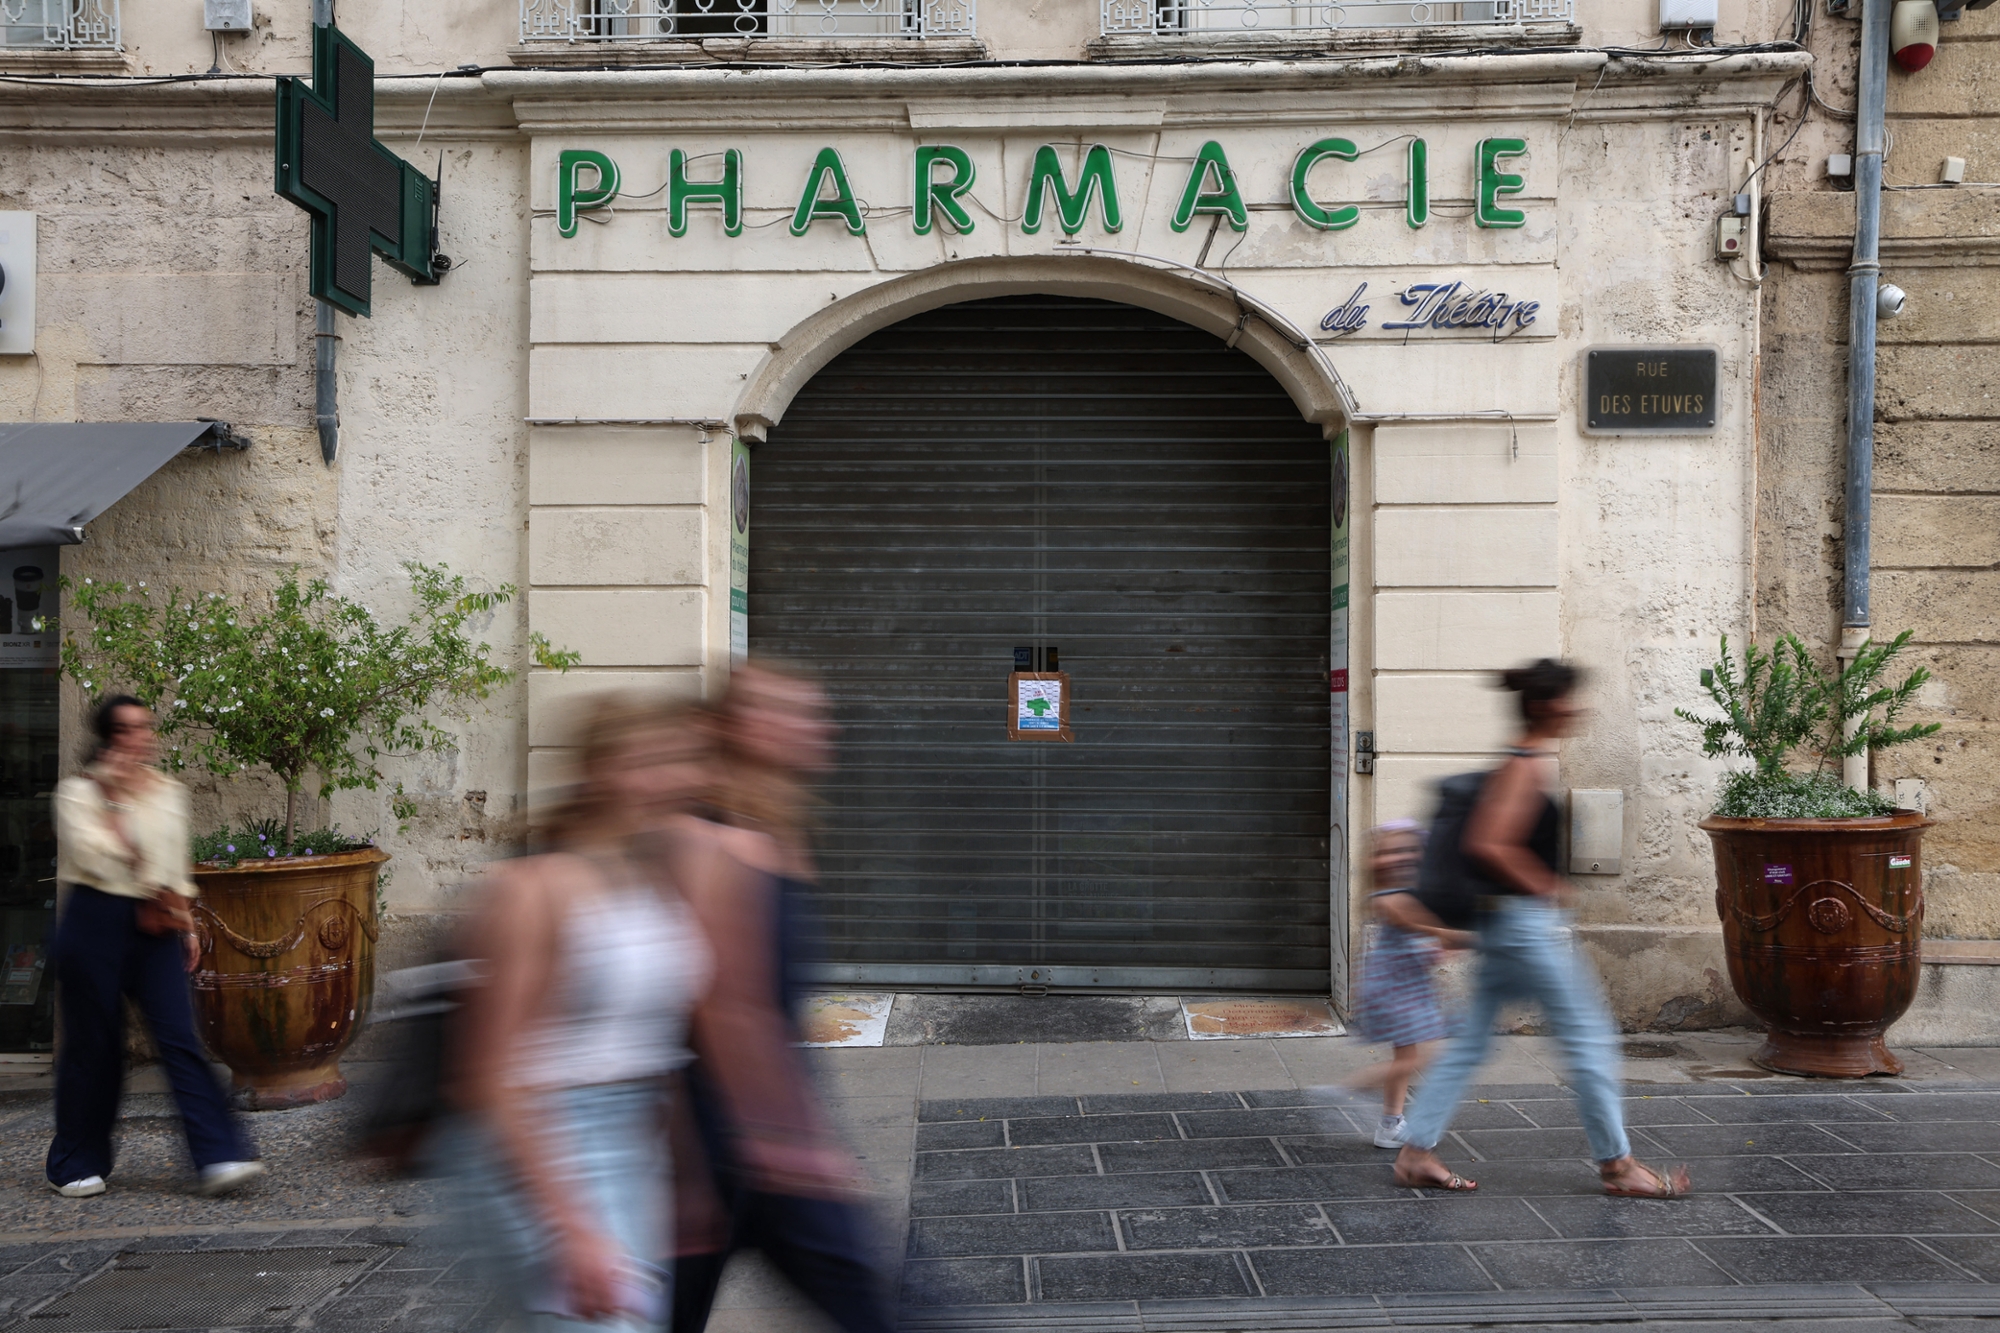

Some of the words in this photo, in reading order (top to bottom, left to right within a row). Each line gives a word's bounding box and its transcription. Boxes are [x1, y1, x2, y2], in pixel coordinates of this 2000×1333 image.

[556, 134, 1527, 238] PHARMACIE
[1320, 281, 1370, 332] du
[1637, 362, 1668, 377] RUE
[1600, 395, 1631, 414] DES
[1641, 394, 1704, 414] ETUVES
[1014, 651, 1029, 660] ADT
